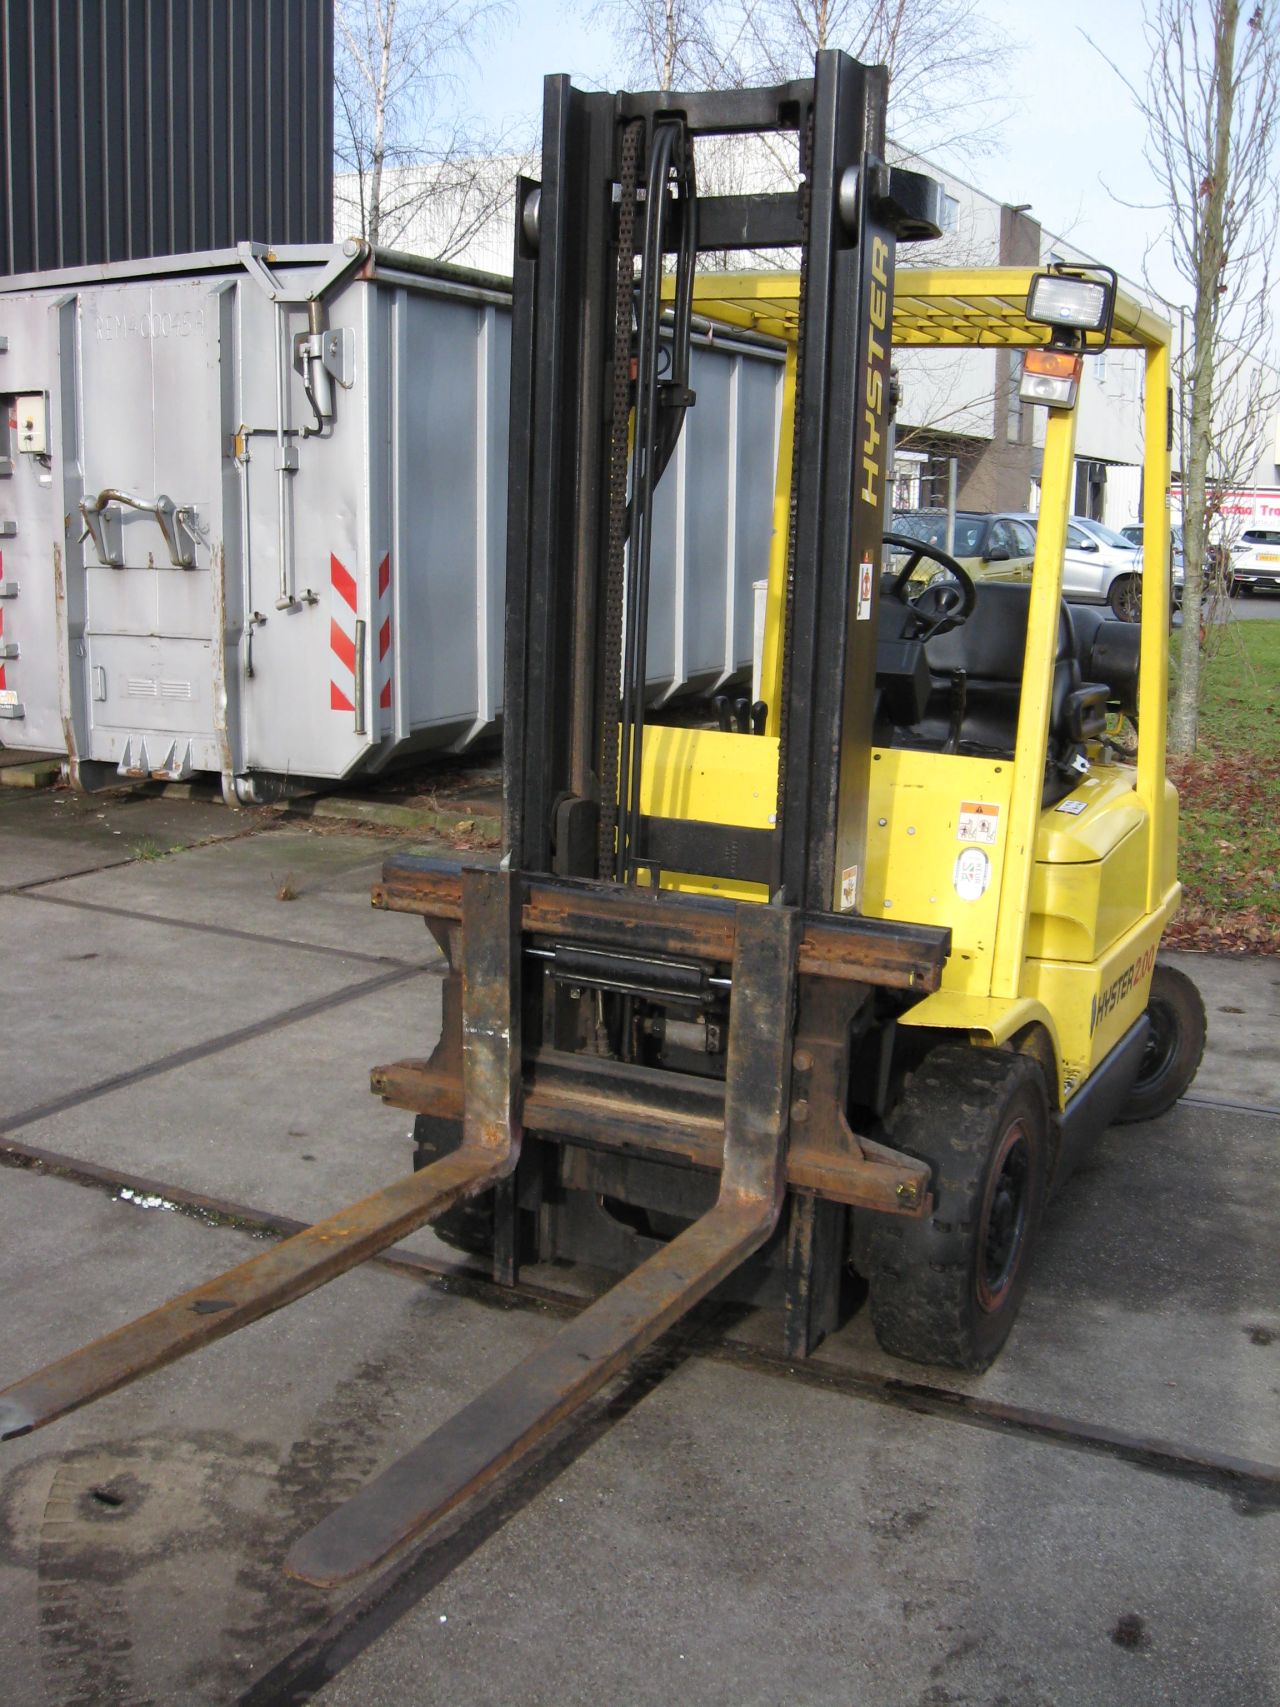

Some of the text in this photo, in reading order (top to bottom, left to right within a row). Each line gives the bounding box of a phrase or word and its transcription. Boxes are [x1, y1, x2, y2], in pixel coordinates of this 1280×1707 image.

[861, 235, 888, 507] HYSTER
[1095, 943, 1156, 1027] HYSTER 200
